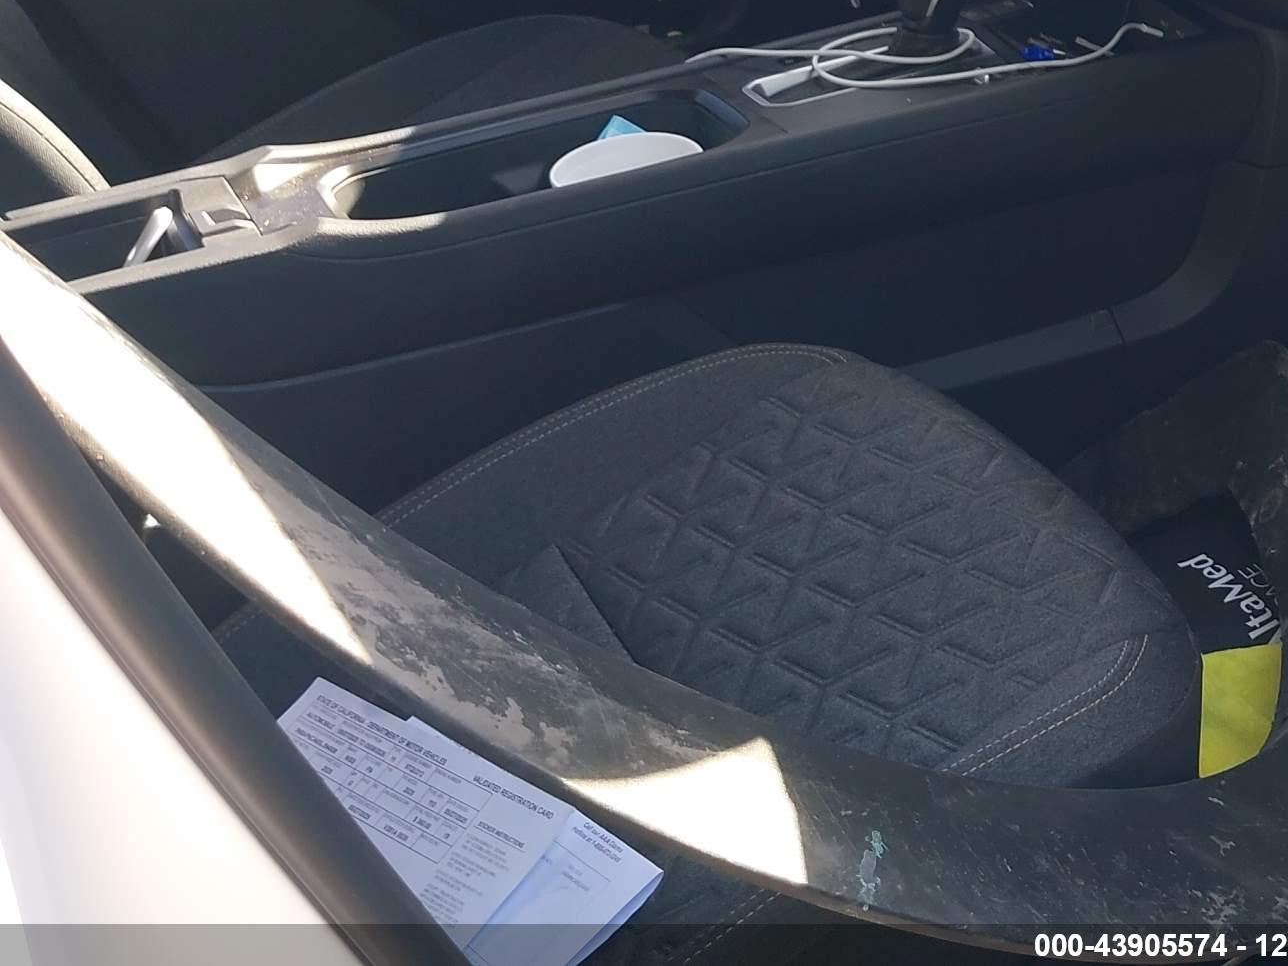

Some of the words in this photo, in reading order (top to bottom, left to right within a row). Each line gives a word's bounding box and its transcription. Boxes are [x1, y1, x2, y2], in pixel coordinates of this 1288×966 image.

[318, 695, 331, 705] STATE
[338, 706, 366, 723] CALIFORNIA
[368, 721, 399, 740] DEPARTMENT
[406, 741, 423, 753] MOTOR
[423, 750, 447, 765] VEHICLES
[473, 775, 501, 792] VALIDATED
[500, 789, 537, 811] REGISTRATION
[537, 807, 554, 819] CARD
